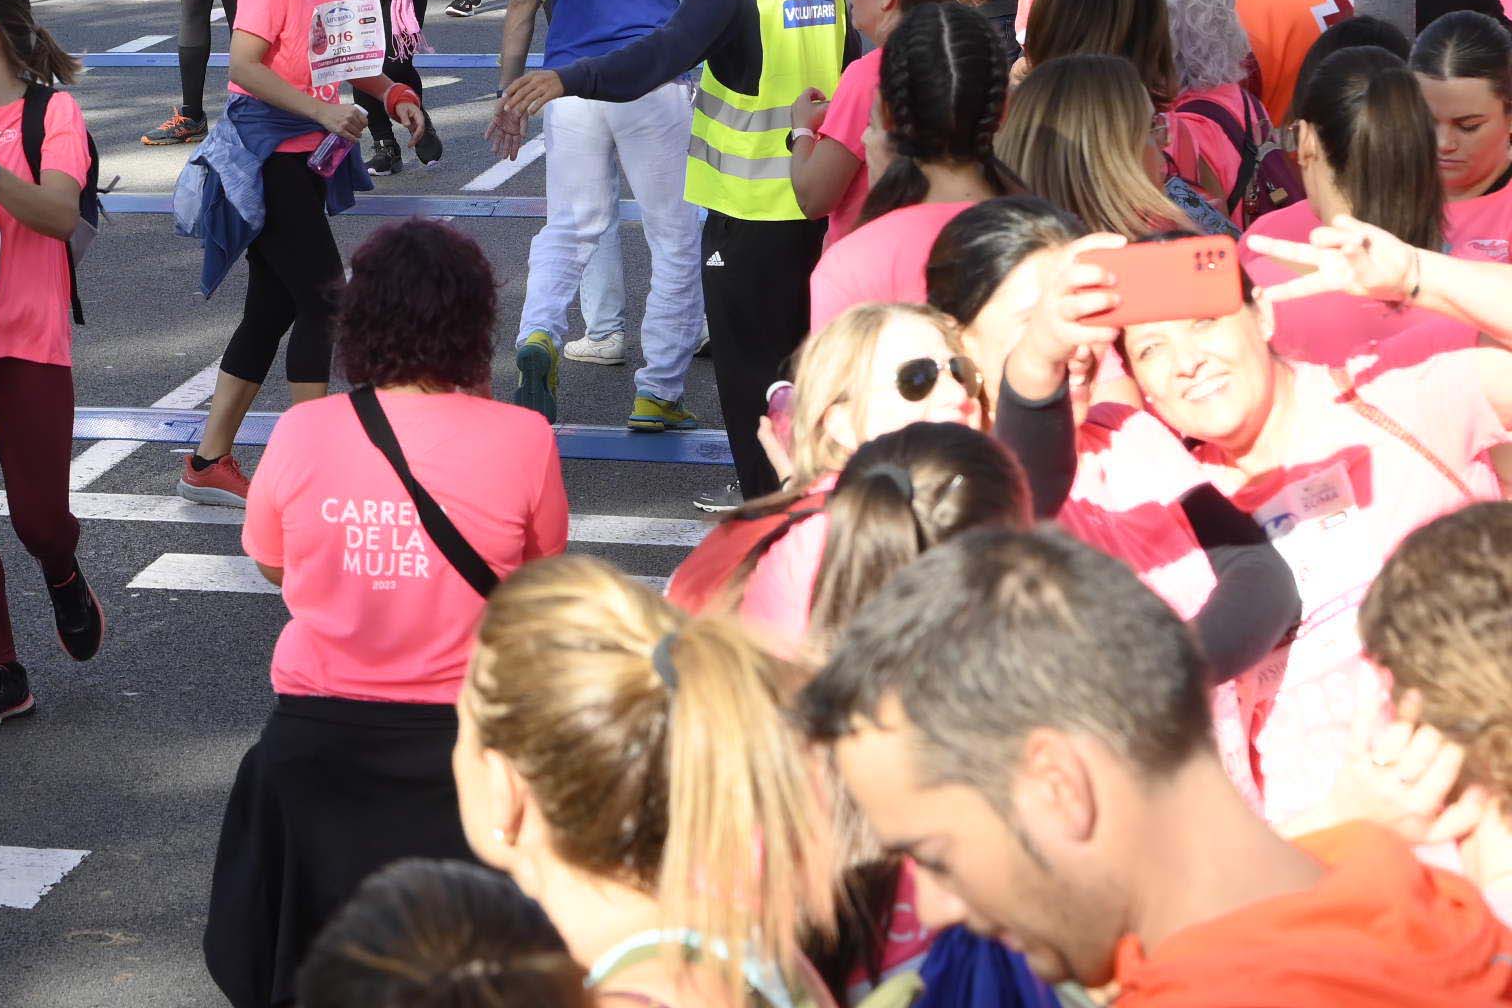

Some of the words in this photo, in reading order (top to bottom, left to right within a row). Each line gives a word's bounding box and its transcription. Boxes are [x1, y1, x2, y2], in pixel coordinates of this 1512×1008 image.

[785, 3, 835, 22] VOLUNTARIS
[328, 31, 354, 45] 016
[345, 525, 380, 551] DE
[392, 527, 426, 552] LA
[343, 550, 430, 579] MUJER
